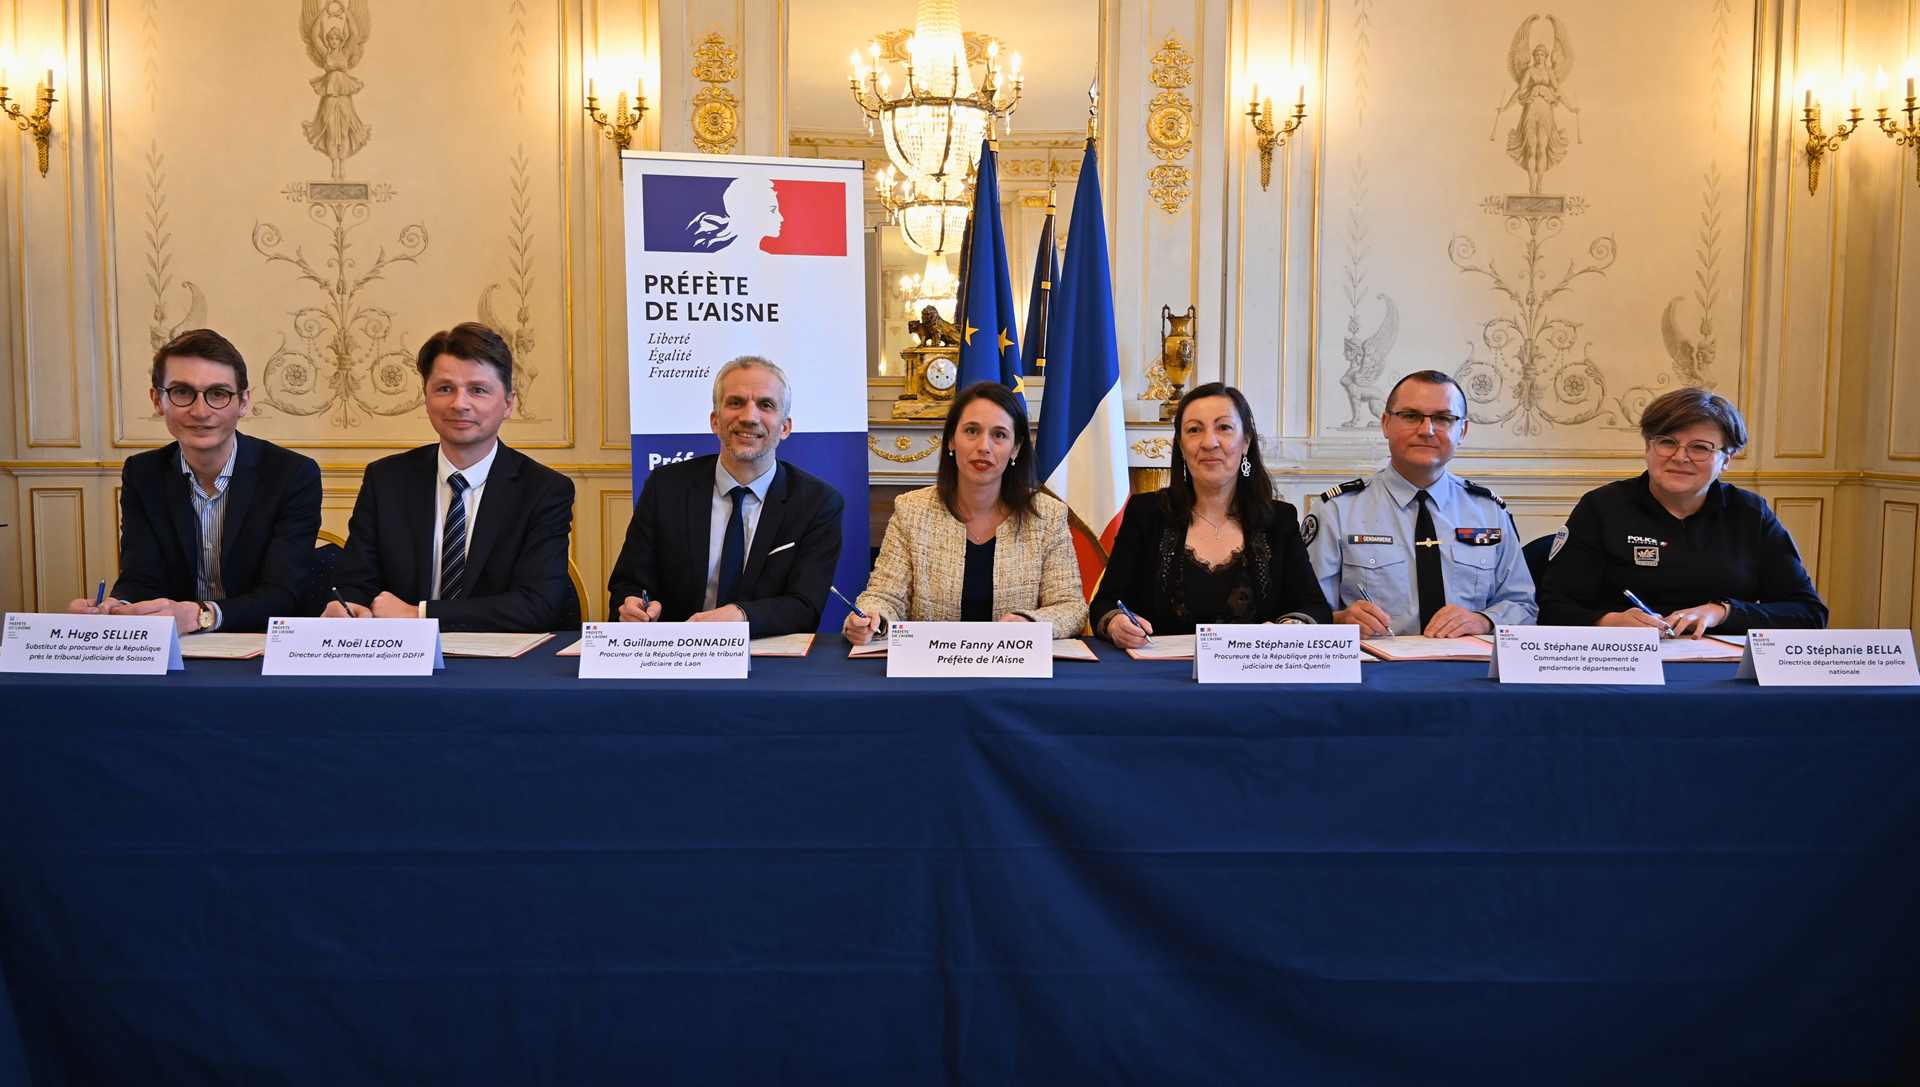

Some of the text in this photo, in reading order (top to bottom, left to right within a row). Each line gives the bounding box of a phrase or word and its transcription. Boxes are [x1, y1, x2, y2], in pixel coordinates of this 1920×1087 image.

[644, 271, 748, 296] PRÉFÈTE
[645, 302, 678, 320] DE
[648, 333, 690, 344] Liberté
[648, 348, 692, 363] Égalité
[648, 366, 710, 378] Fraternité
[50, 629, 148, 642] M. Hugo SELLIER
[123, 644, 161, 652] République
[338, 638, 362, 648] Noël
[365, 640, 403, 648] LEDON
[608, 638, 744, 647] M. Guillaume DONNADIEU
[929, 640, 1032, 652] Mme Fanny ANOR
[1228, 640, 1251, 648] Mme
[1255, 640, 1304, 651] Stéphanie
[1307, 640, 1352, 648] LESCAUT
[1521, 642, 1658, 652] COL Stéphane AUROUSSEAU
[1785, 646, 1802, 654] CD
[1807, 646, 1862, 657] Stéphanie
[1867, 646, 1901, 654] BELLA
[937, 655, 973, 666] Préfète
[976, 656, 988, 664] de
